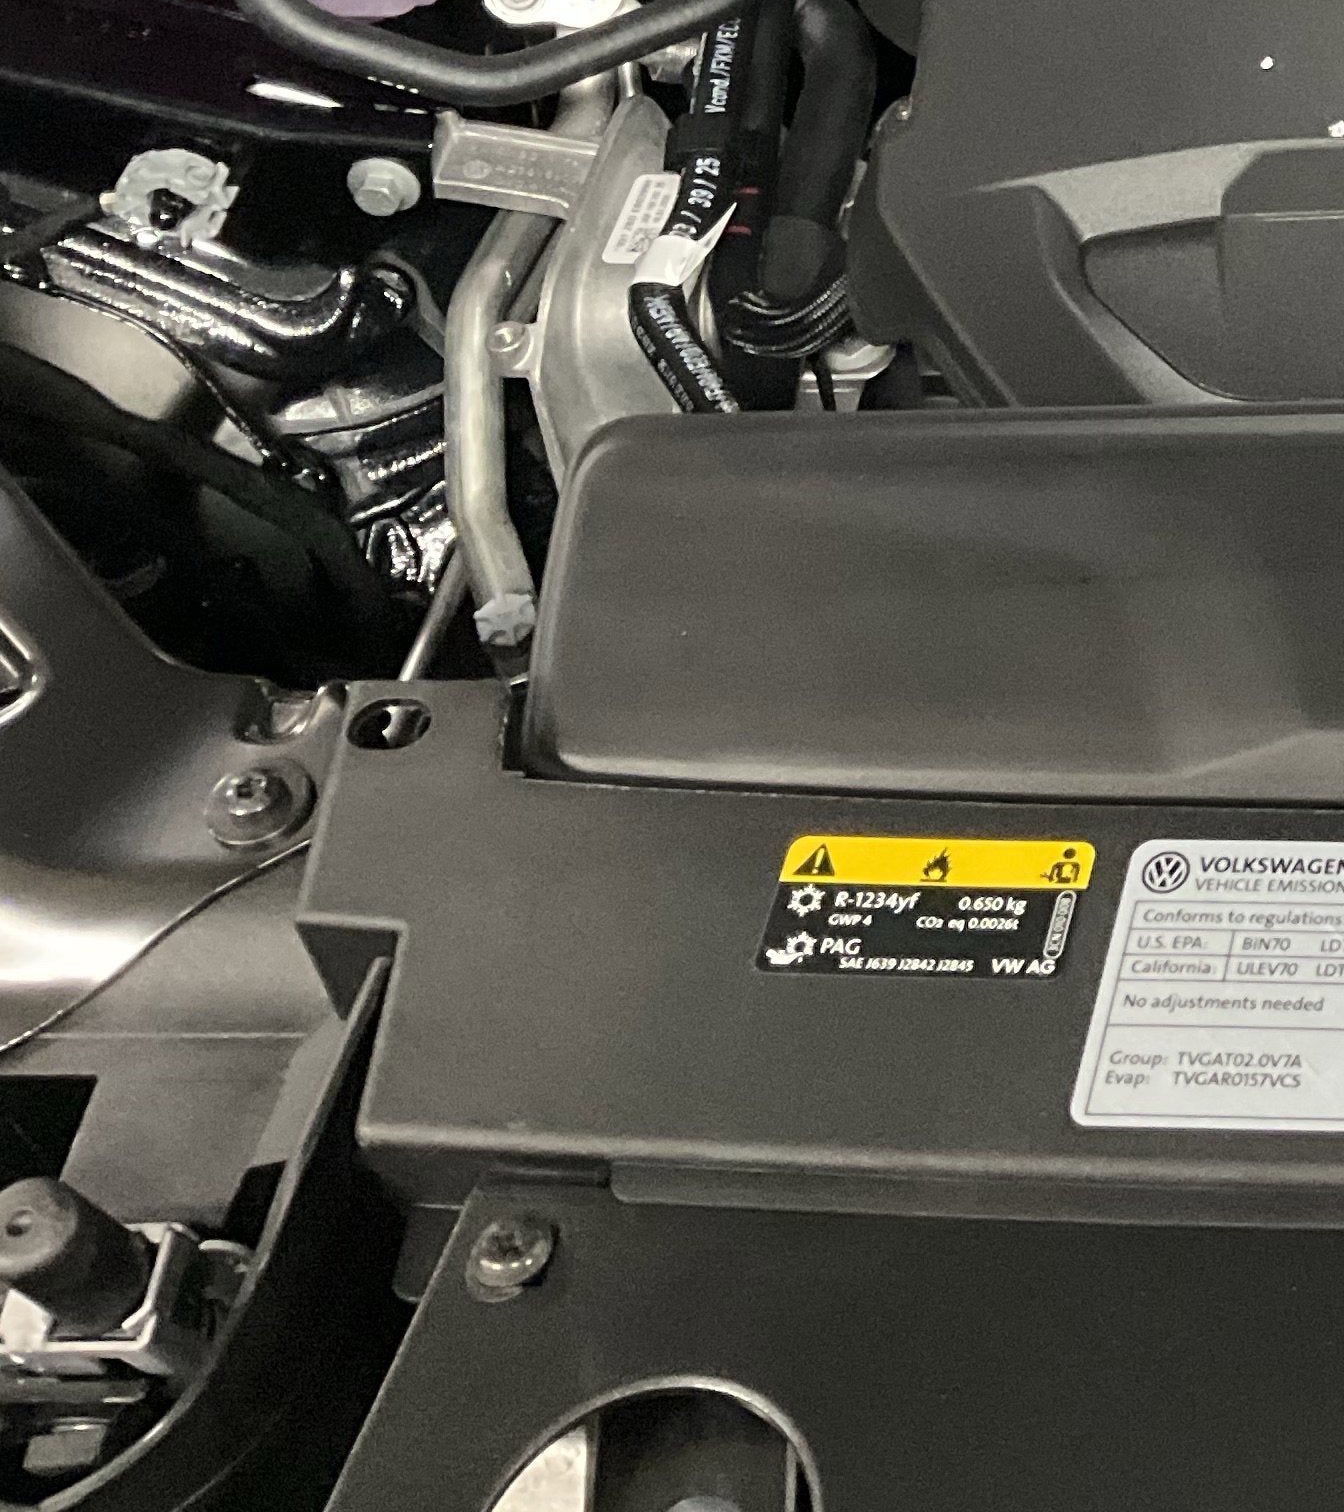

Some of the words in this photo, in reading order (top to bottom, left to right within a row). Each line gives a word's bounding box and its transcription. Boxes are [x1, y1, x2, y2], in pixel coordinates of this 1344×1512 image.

[1195, 878, 1266, 892] VEHICLE
[834, 891, 921, 913] R-1234yf
[958, 896, 1004, 912] 0.650
[1005, 897, 1027, 915] kg
[828, 914, 861, 927] GWP
[862, 915, 872, 927] 4
[947, 919, 965, 932] eq
[1142, 909, 1223, 924] Conforms
[1228, 911, 1244, 925] to
[820, 938, 862, 954] PAG
[1241, 938, 1291, 952] BIN70
[838, 957, 864, 970] SAE
[991, 958, 1023, 974] VW
[1025, 959, 1056, 975] AG
[1236, 961, 1298, 976] ULEV70
[1123, 994, 1147, 1008] No
[1150, 994, 1257, 1013] adjustments
[1261, 997, 1325, 1012] needed
